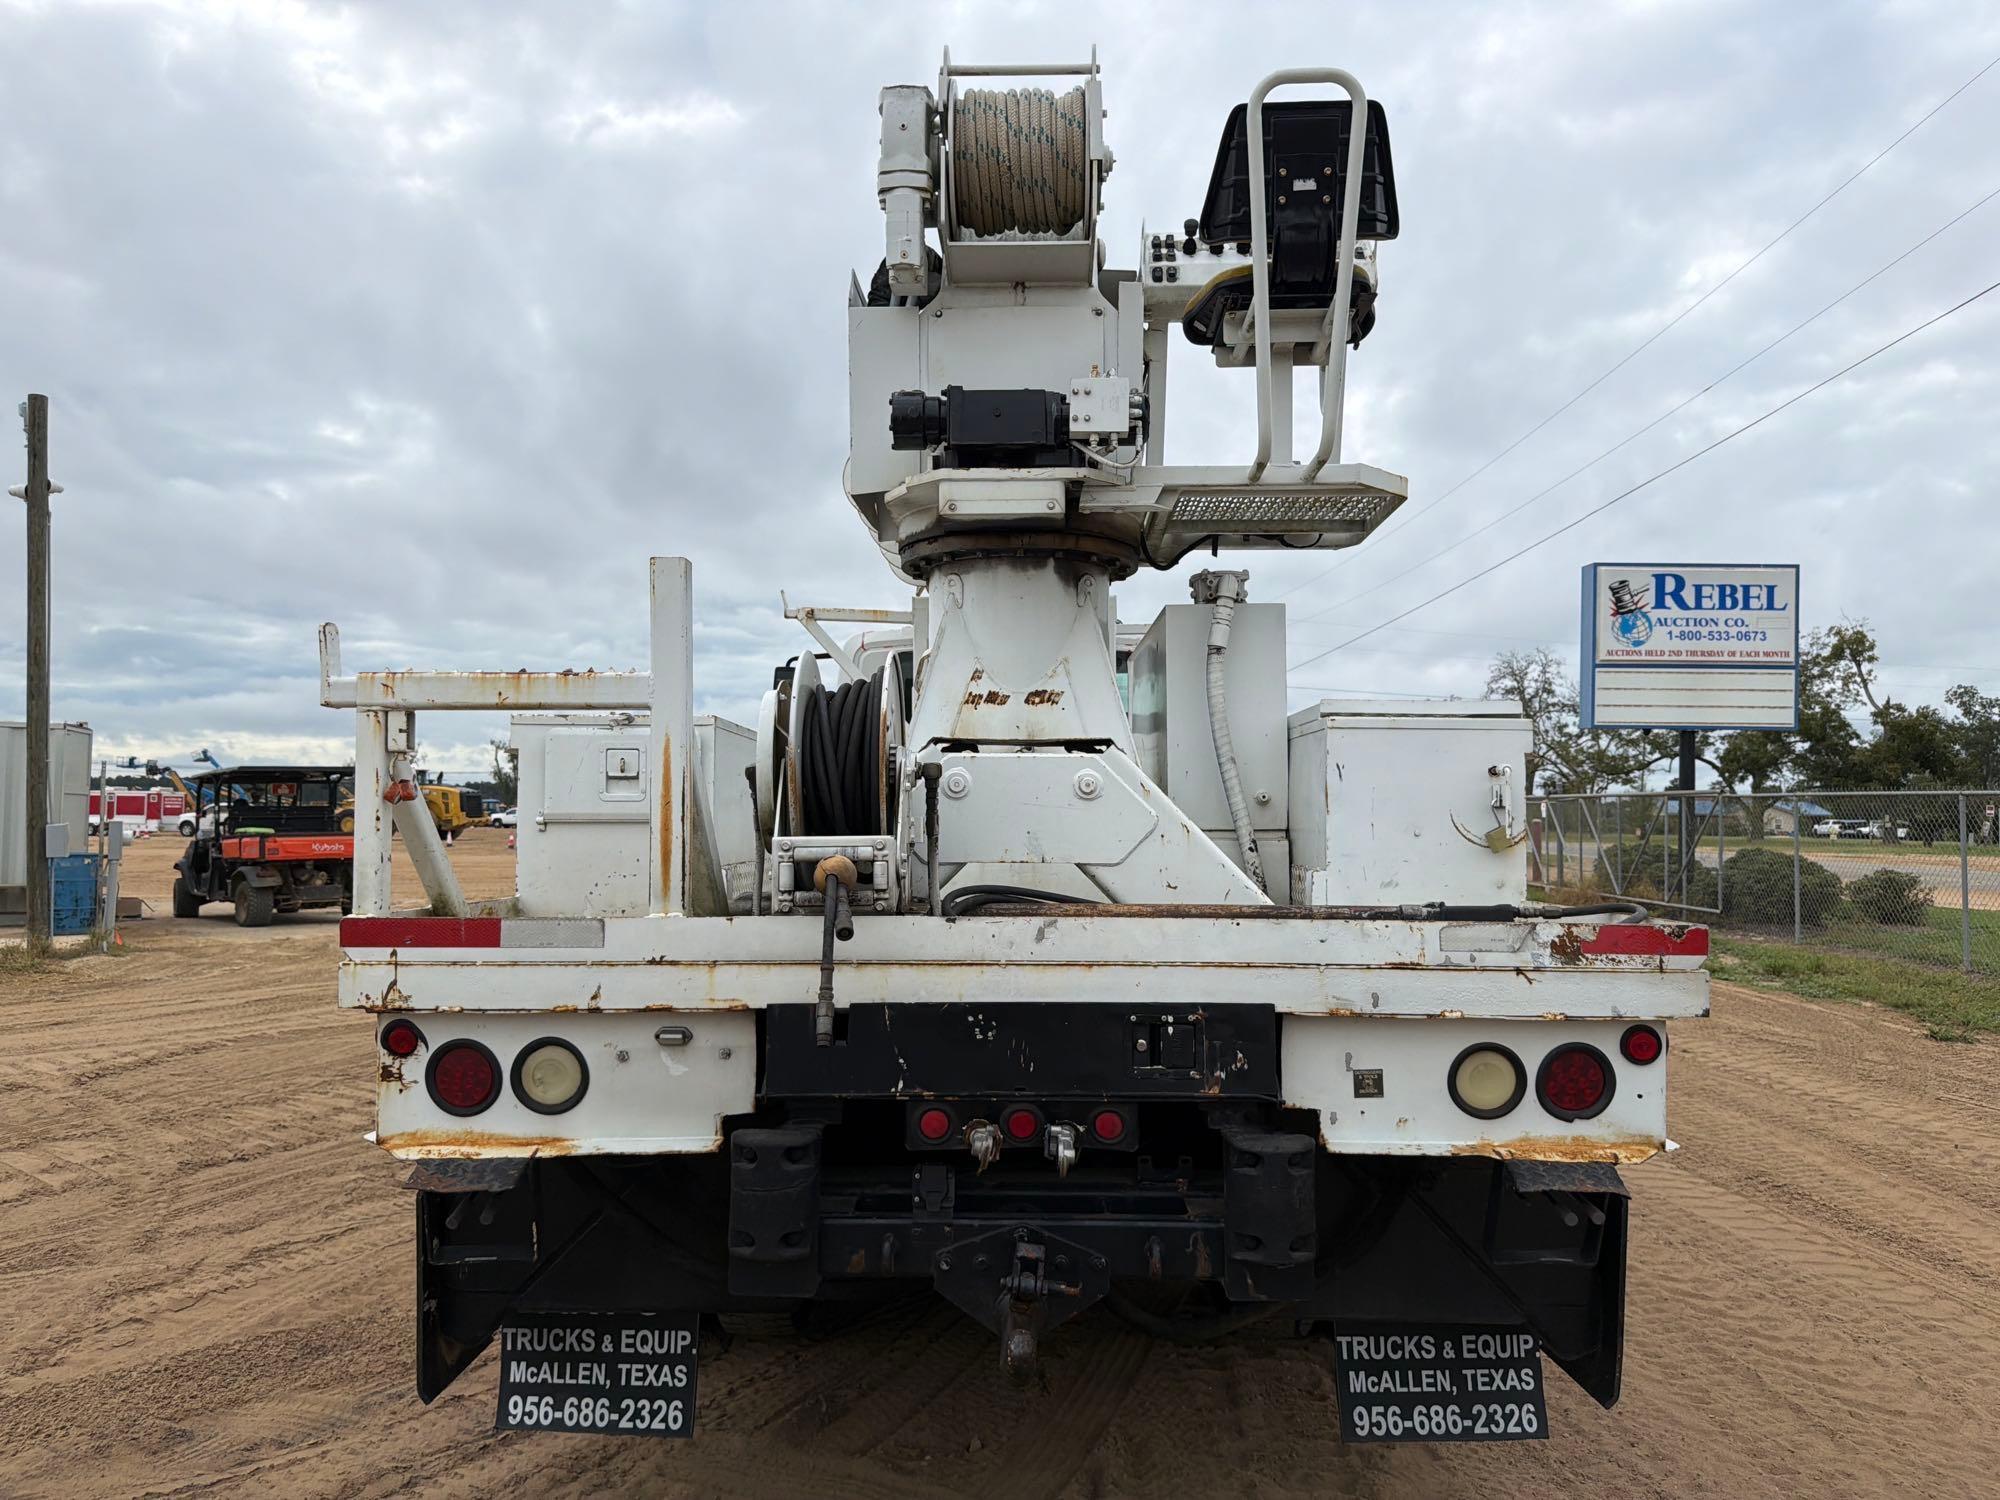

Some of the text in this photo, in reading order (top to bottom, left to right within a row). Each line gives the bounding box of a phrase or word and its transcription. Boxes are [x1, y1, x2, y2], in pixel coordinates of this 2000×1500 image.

[1654, 617, 1749, 628] AUCTION CO.
[1667, 630, 1767, 642] 1-800-533-0673
[1605, 649, 1643, 657] AUCTIONS
[503, 1328, 697, 1355] TRUCKS & EQUIP.
[1336, 1334, 1540, 1360] TRUCKS & EQUIP.
[509, 1361, 688, 1389] McALLEN, TEXAS
[1349, 1368, 1535, 1395] McALLEN, TEXAS
[507, 1395, 684, 1431] 956-686-2326
[1352, 1403, 1538, 1437] 956-686-2326
